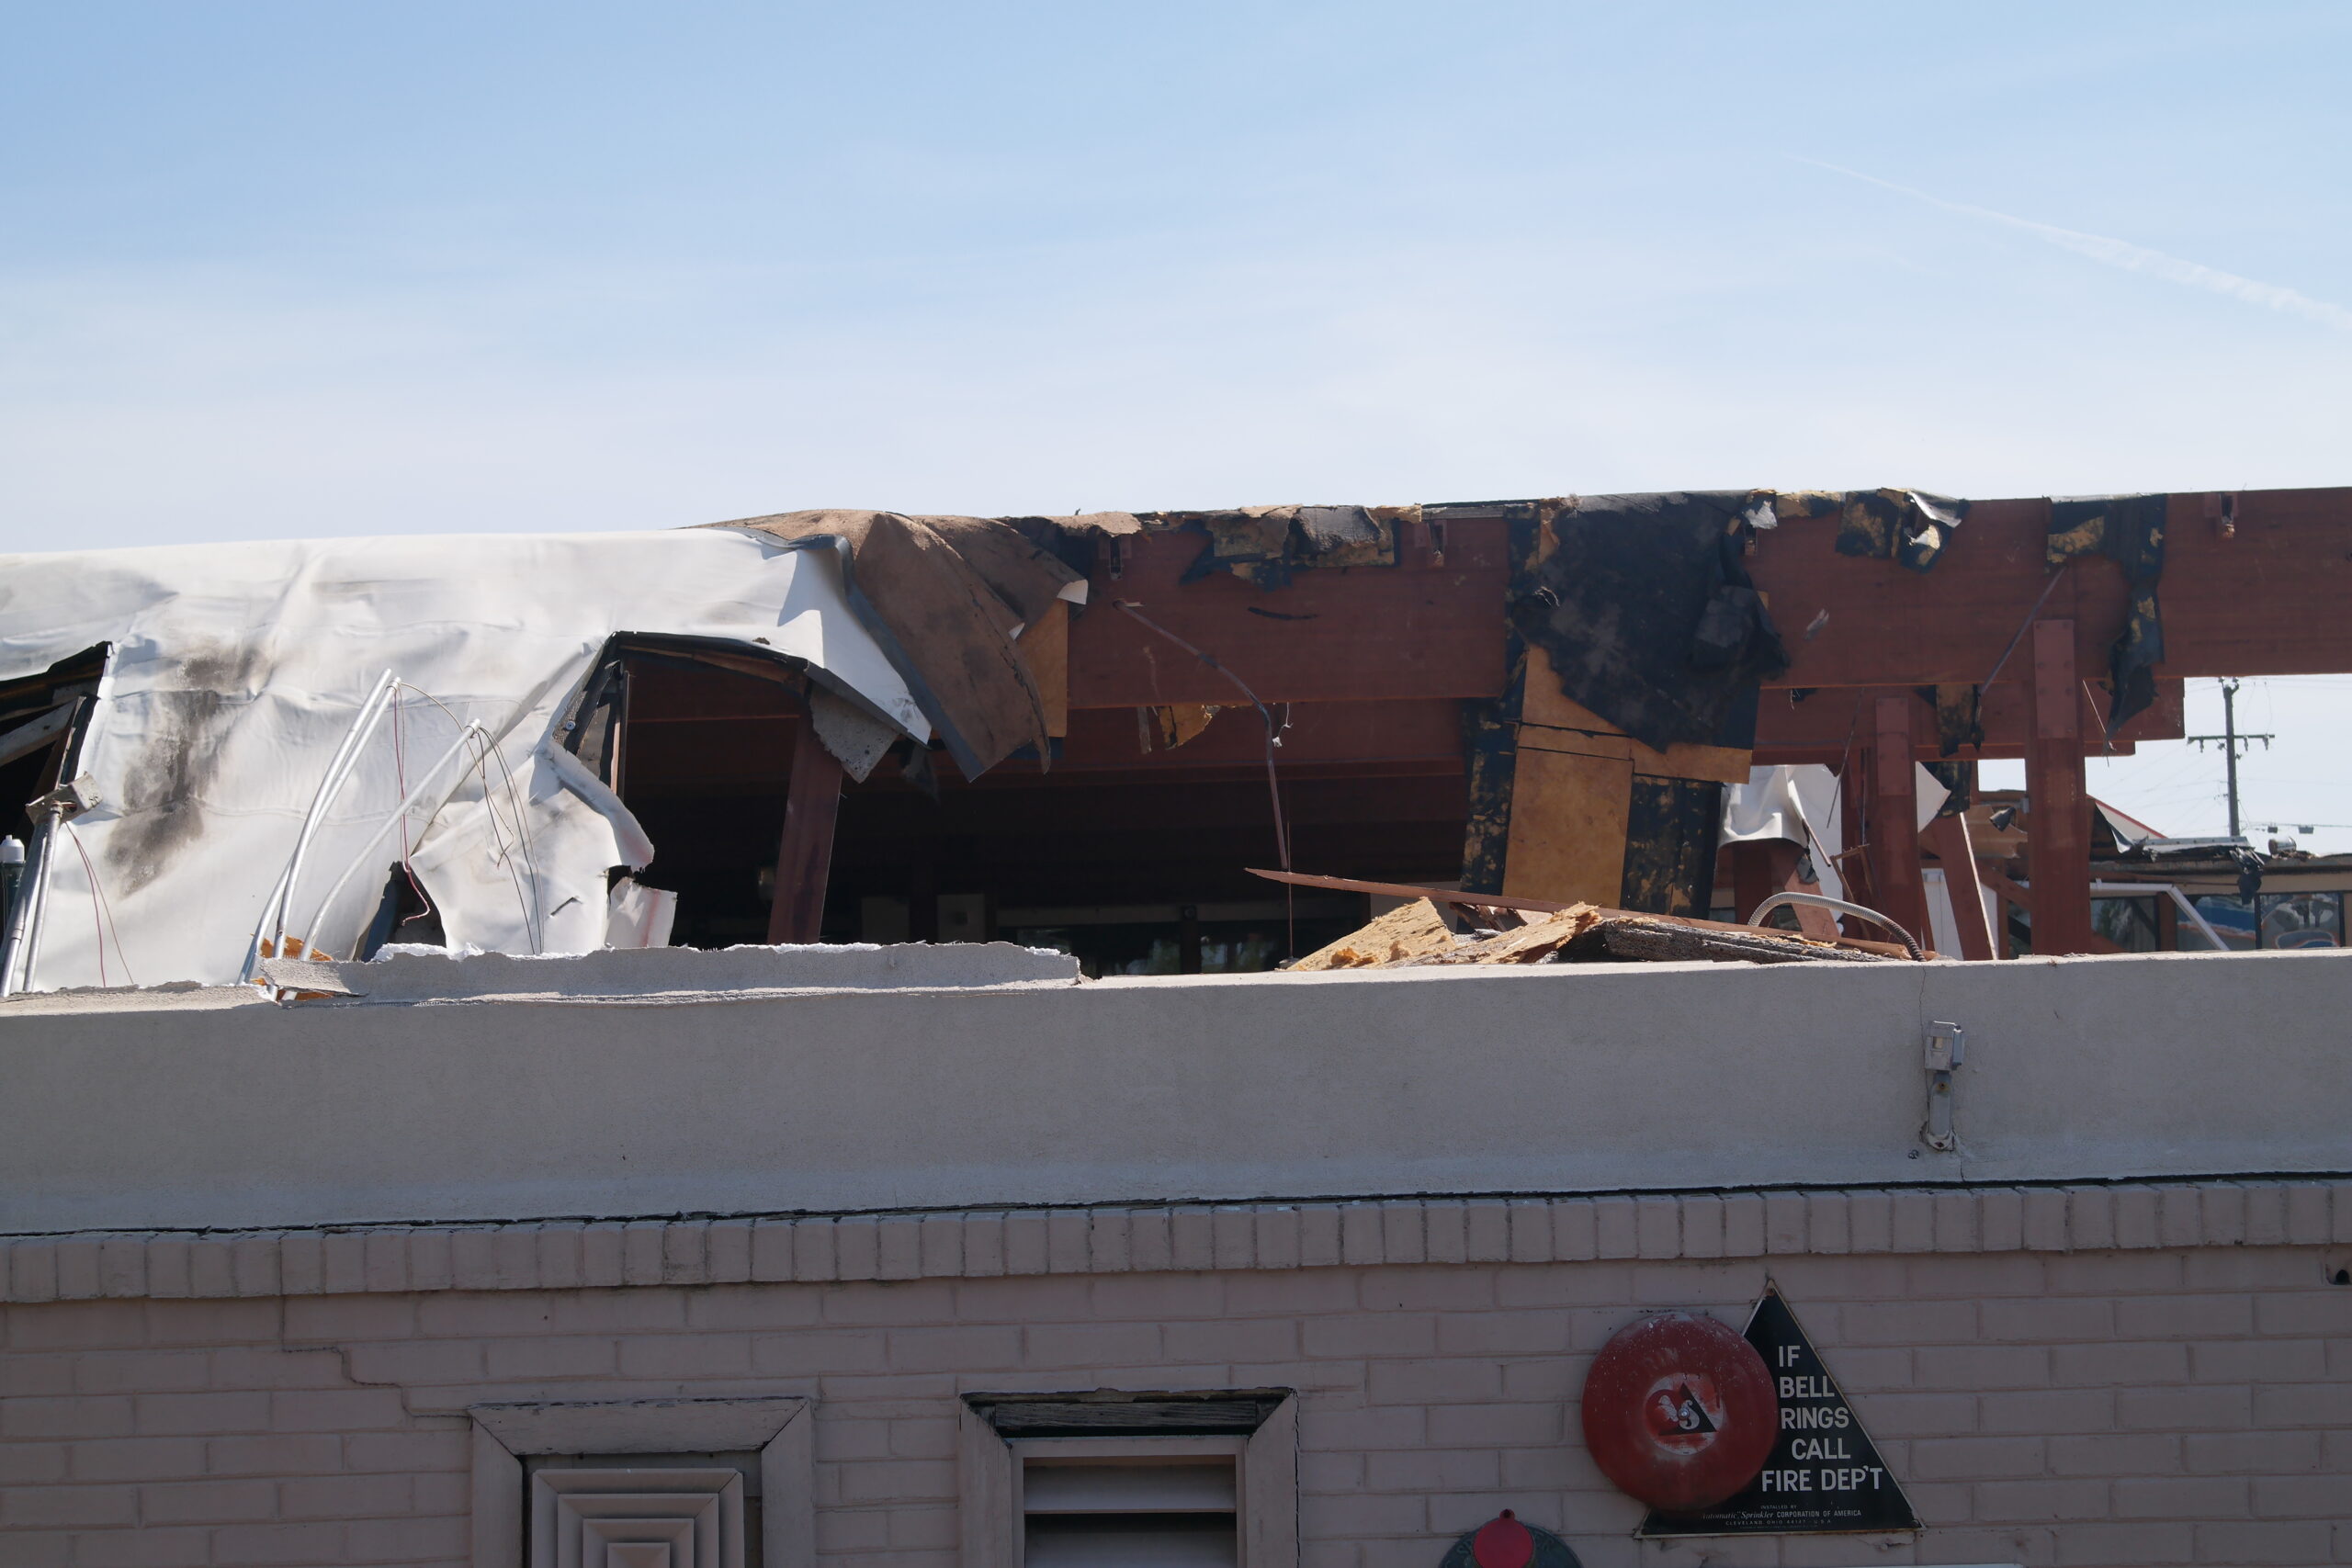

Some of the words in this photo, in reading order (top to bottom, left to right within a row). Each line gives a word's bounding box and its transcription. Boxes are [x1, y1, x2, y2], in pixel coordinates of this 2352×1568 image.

[1779, 1345, 1801, 1368] IF
[1779, 1375, 1836, 1399] BELL
[1781, 1406, 1849, 1430] RINGS
[1792, 1437, 1851, 1461] CALL
[1761, 1469, 1812, 1493] FIRE
[1821, 1464, 1883, 1492] DEP'T
[1741, 1510, 1774, 1520] Sprinkler
[1777, 1509, 1820, 1518] CORPORATION
[1823, 1509, 1831, 1517] OF
[1834, 1508, 1861, 1517] AMERICA
